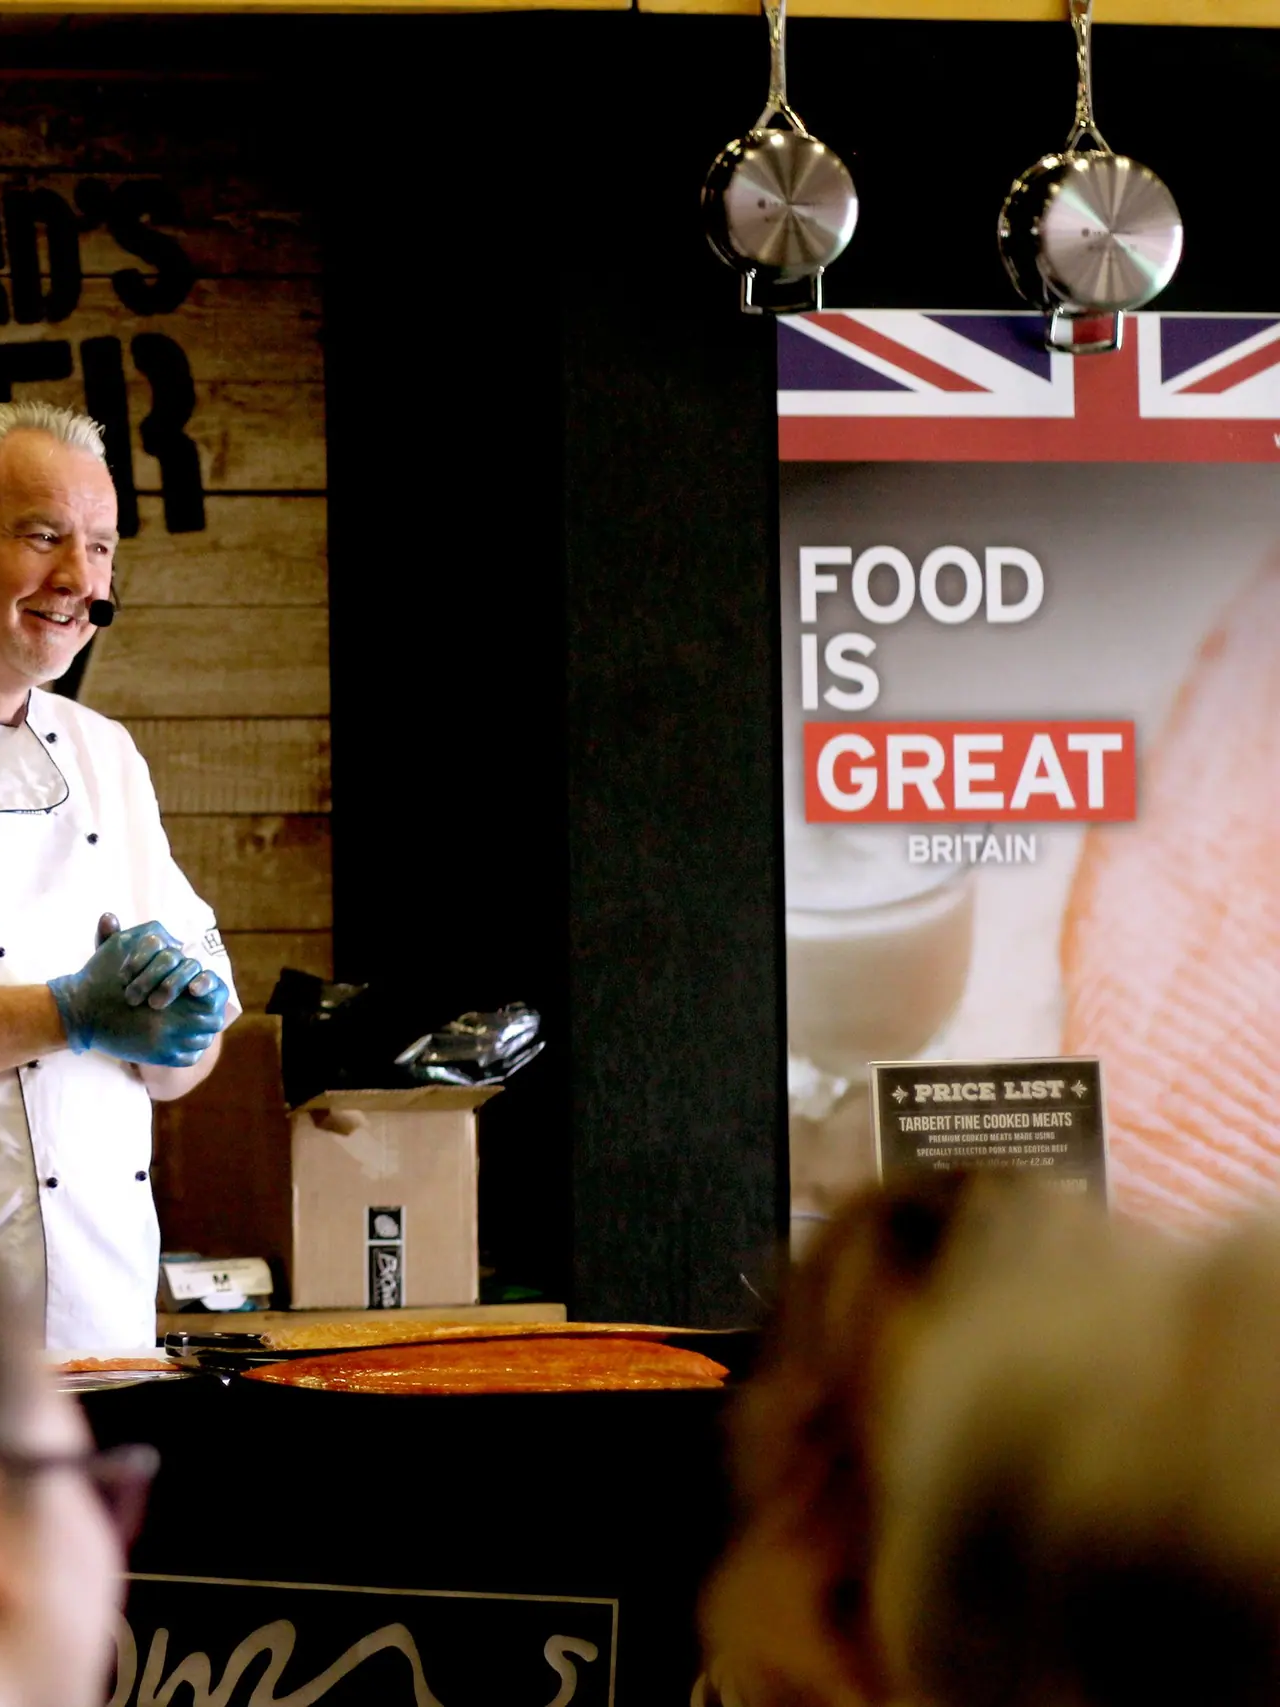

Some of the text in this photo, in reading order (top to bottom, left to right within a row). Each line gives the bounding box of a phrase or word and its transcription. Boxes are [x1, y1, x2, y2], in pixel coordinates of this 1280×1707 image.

[799, 545, 1045, 624] FOOD
[801, 632, 880, 711] IS
[816, 733, 1123, 812] GREAT
[908, 834, 1037, 863] BRITAIN
[914, 1080, 1065, 1103] PRICE LIST
[899, 1112, 1072, 1132] TARBERT FINE COOKED MEATS
[917, 1148, 952, 1157] SPECIALLY
[1008, 1145, 1022, 1153] AND
[928, 1135, 960, 1143] PREMIUM
[962, 1134, 988, 1142] COOKED
[990, 1133, 1012, 1141] MEATS
